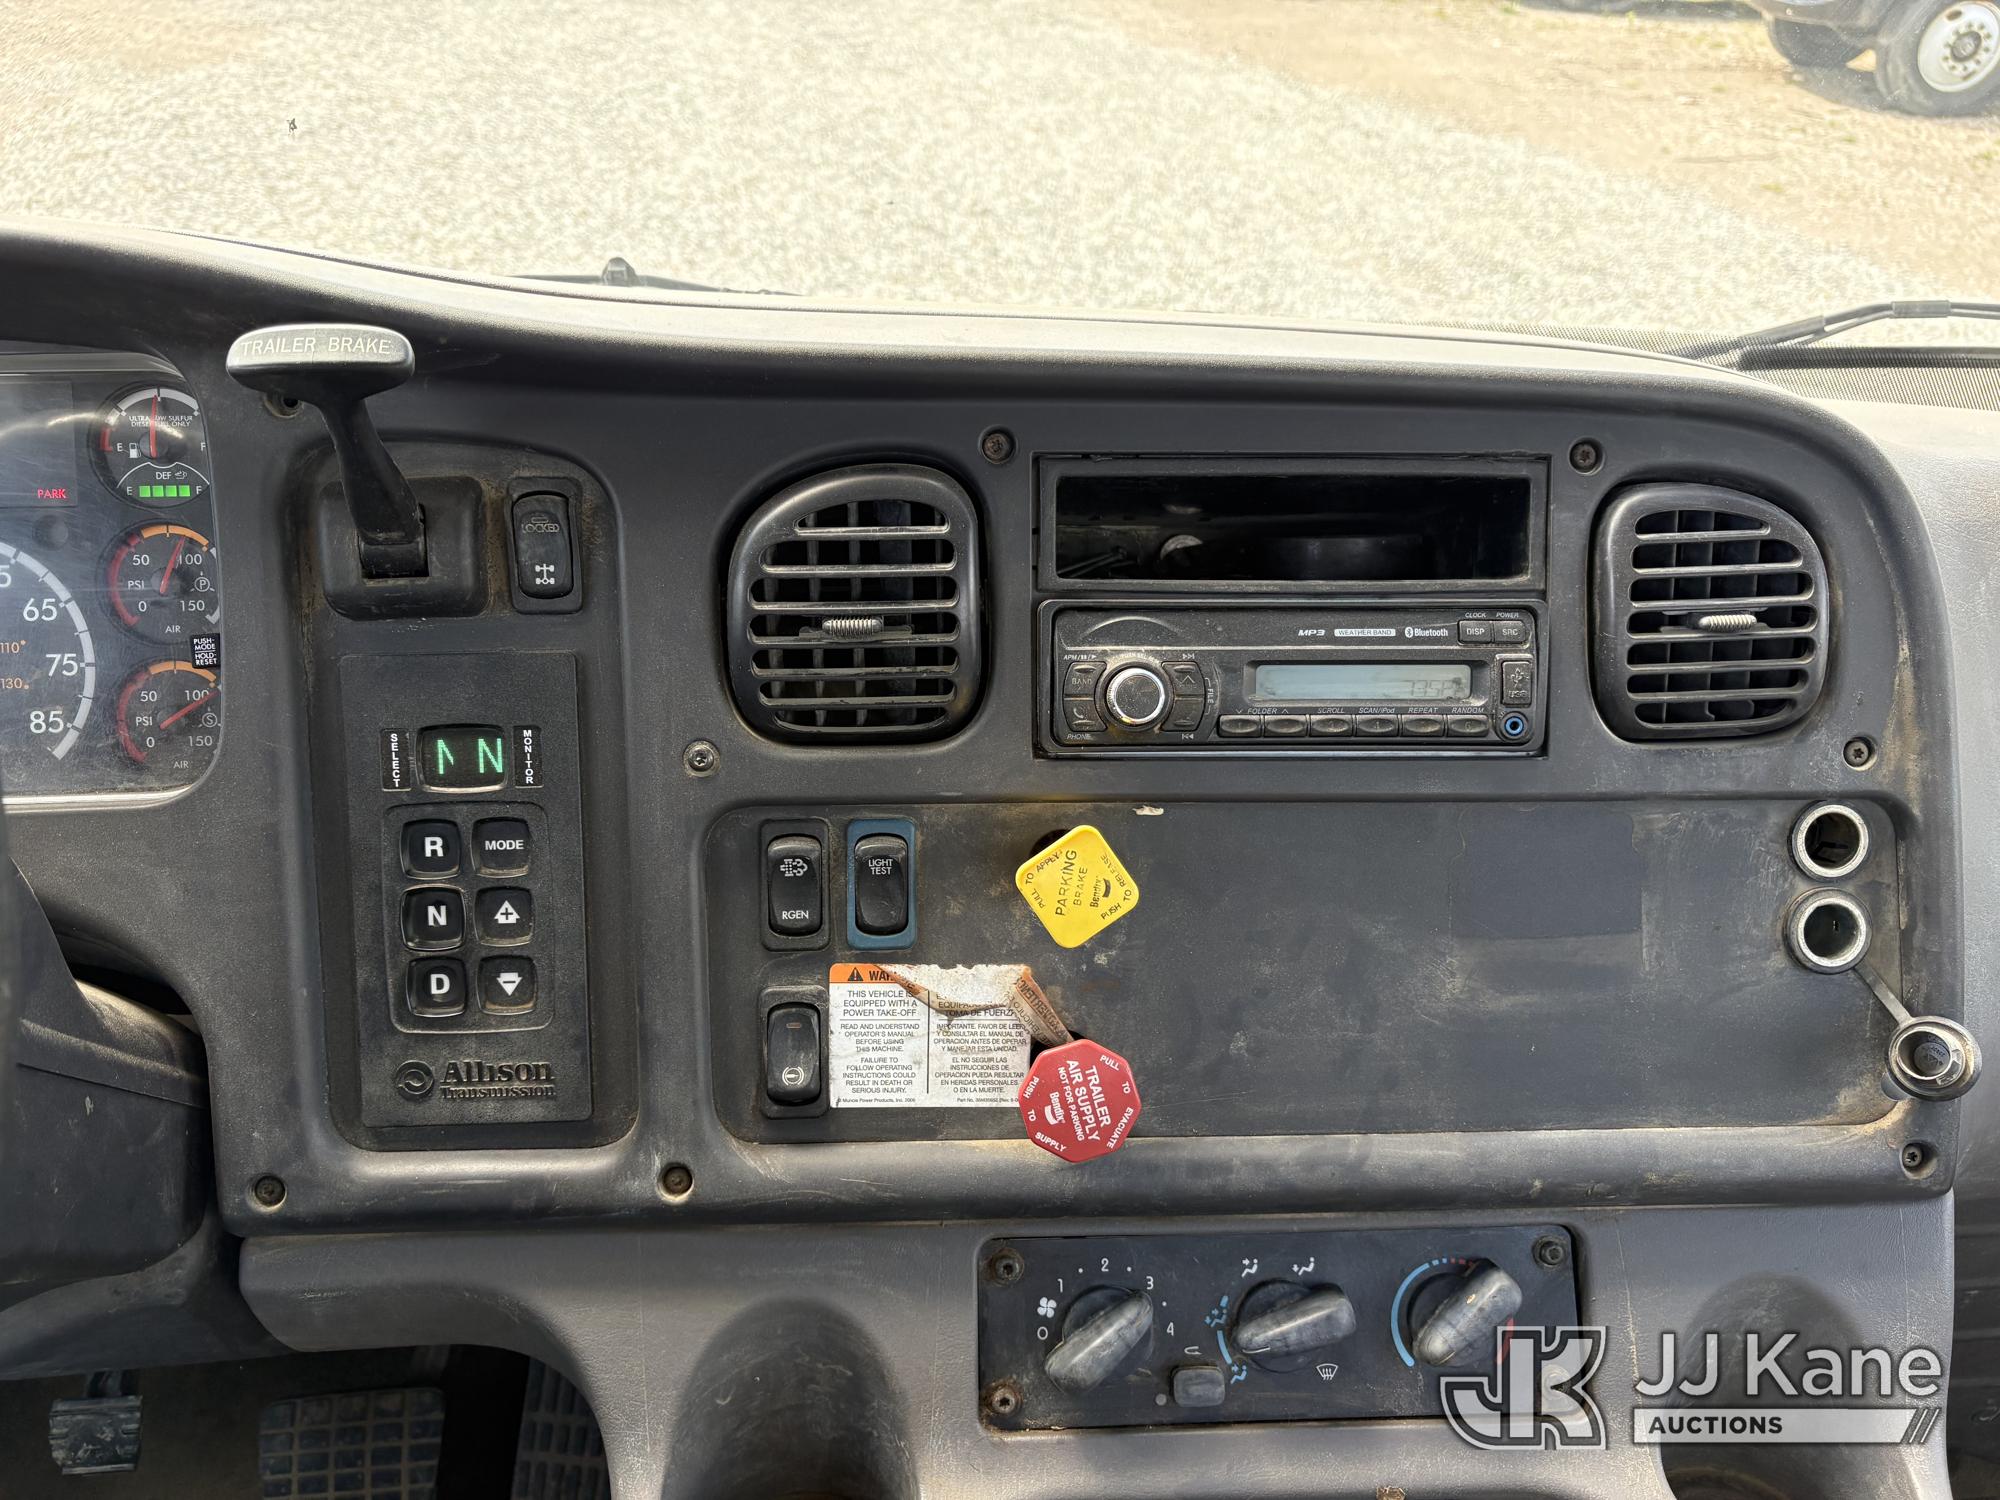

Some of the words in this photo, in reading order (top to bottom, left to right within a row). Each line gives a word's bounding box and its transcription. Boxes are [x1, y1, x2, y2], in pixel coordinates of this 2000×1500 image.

[240, 338, 316, 356] TRAILER
[328, 337, 393, 354] BRAKE
[117, 443, 123, 452] E
[156, 472, 172, 480] DEF
[38, 489, 66, 498] PARK
[127, 486, 133, 495] E
[196, 486, 202, 495] F
[132, 554, 149, 566] 50
[179, 554, 202, 565] 100
[128, 580, 145, 590] PSI
[23, 598, 58, 622] 65
[139, 601, 147, 612] 0
[180, 600, 205, 611] 150
[165, 625, 181, 633] AIR
[1414, 628, 1448, 637] Bluetooth
[1466, 627, 1485, 636] DISP
[1502, 628, 1518, 636] SRC
[46, 653, 79, 677] 75
[195, 658, 217, 666] RESET
[140, 691, 157, 702] 50
[185, 690, 209, 701] 100
[1207, 688, 1215, 704] FILE
[30, 711, 64, 734] 85
[136, 716, 153, 726] PSI
[147, 737, 155, 747] 0
[189, 735, 212, 746] 150
[391, 733, 400, 787] SELECT
[478, 738, 503, 773] N
[523, 729, 534, 784] MONITOR
[173, 761, 189, 769] AIR
[424, 836, 444, 857] R
[484, 840, 524, 851] MODE
[868, 859, 894, 868] LIGHT
[870, 866, 892, 875] TEST
[1025, 872, 1034, 885] TO
[1055, 849, 1077, 916] PARKING
[1073, 867, 1088, 906] BRAKE
[1031, 888, 1046, 909] PULL
[1101, 902, 1122, 920] PUSH
[1123, 889, 1132, 902] TO
[428, 905, 447, 926] N
[782, 910, 810, 920] RGEN
[430, 973, 450, 994] D
[847, 990, 869, 998] THIS
[869, 990, 904, 998] VEHICLE
[843, 1000, 886, 1008] EQUIPPED
[887, 1000, 911, 1008] WITH
[911, 1000, 918, 1008] A
[843, 1009, 874, 1017] POWER
[876, 1009, 917, 1017] TAKE-OFF
[1099, 1054, 1120, 1071] PULL
[1058, 1067, 1068, 1086] NOT
[1023, 1076, 1040, 1099] PUSH
[1121, 1081, 1131, 1094] TO
[1062, 1085, 1074, 1104] FOR
[1066, 1060, 1083, 1084] AIR
[1075, 1087, 1100, 1141] SUPPLY
[1085, 1065, 1111, 1128] TRAILER
[1050, 1091, 1064, 1121] Bendix
[1027, 1109, 1037, 1122] TO
[1068, 1104, 1085, 1142] PARKING
[1106, 1107, 1134, 1149] EVACUATE
[1035, 1132, 1067, 1152] SUPPLY
[1101, 1258, 1109, 1272] 2
[1057, 1279, 1063, 1293] 1
[1146, 1276, 1154, 1290] 3
[1167, 1322, 1175, 1337] 4
